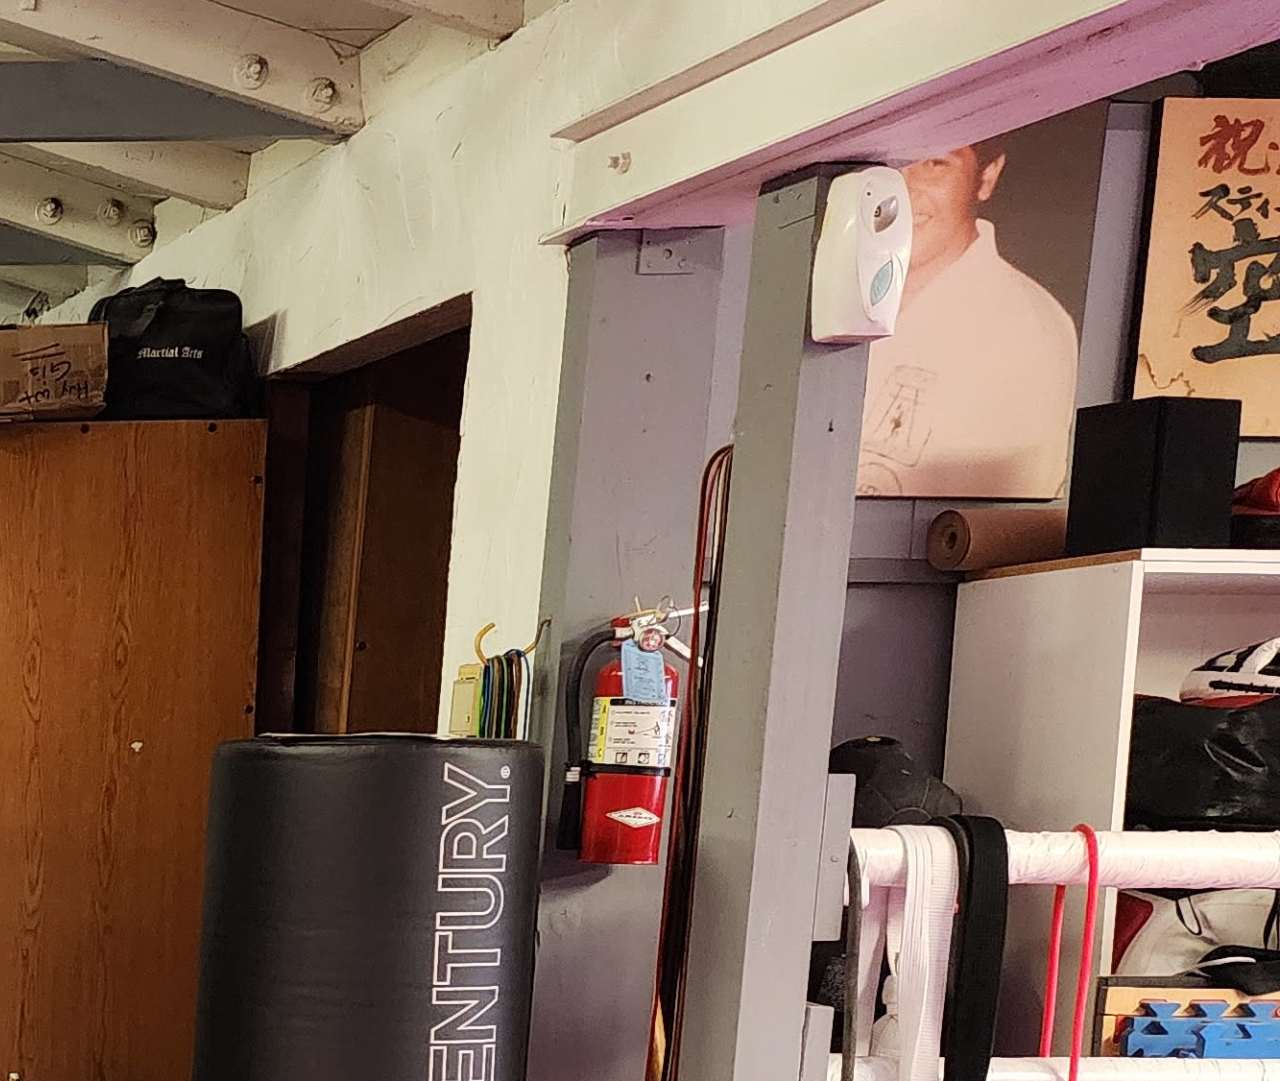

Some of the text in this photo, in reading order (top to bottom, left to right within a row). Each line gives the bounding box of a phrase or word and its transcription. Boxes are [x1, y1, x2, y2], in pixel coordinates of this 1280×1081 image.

[1197, 114, 1280, 176] 祝
[1191, 183, 1280, 220] スティ
[137, 347, 179, 359] Martial
